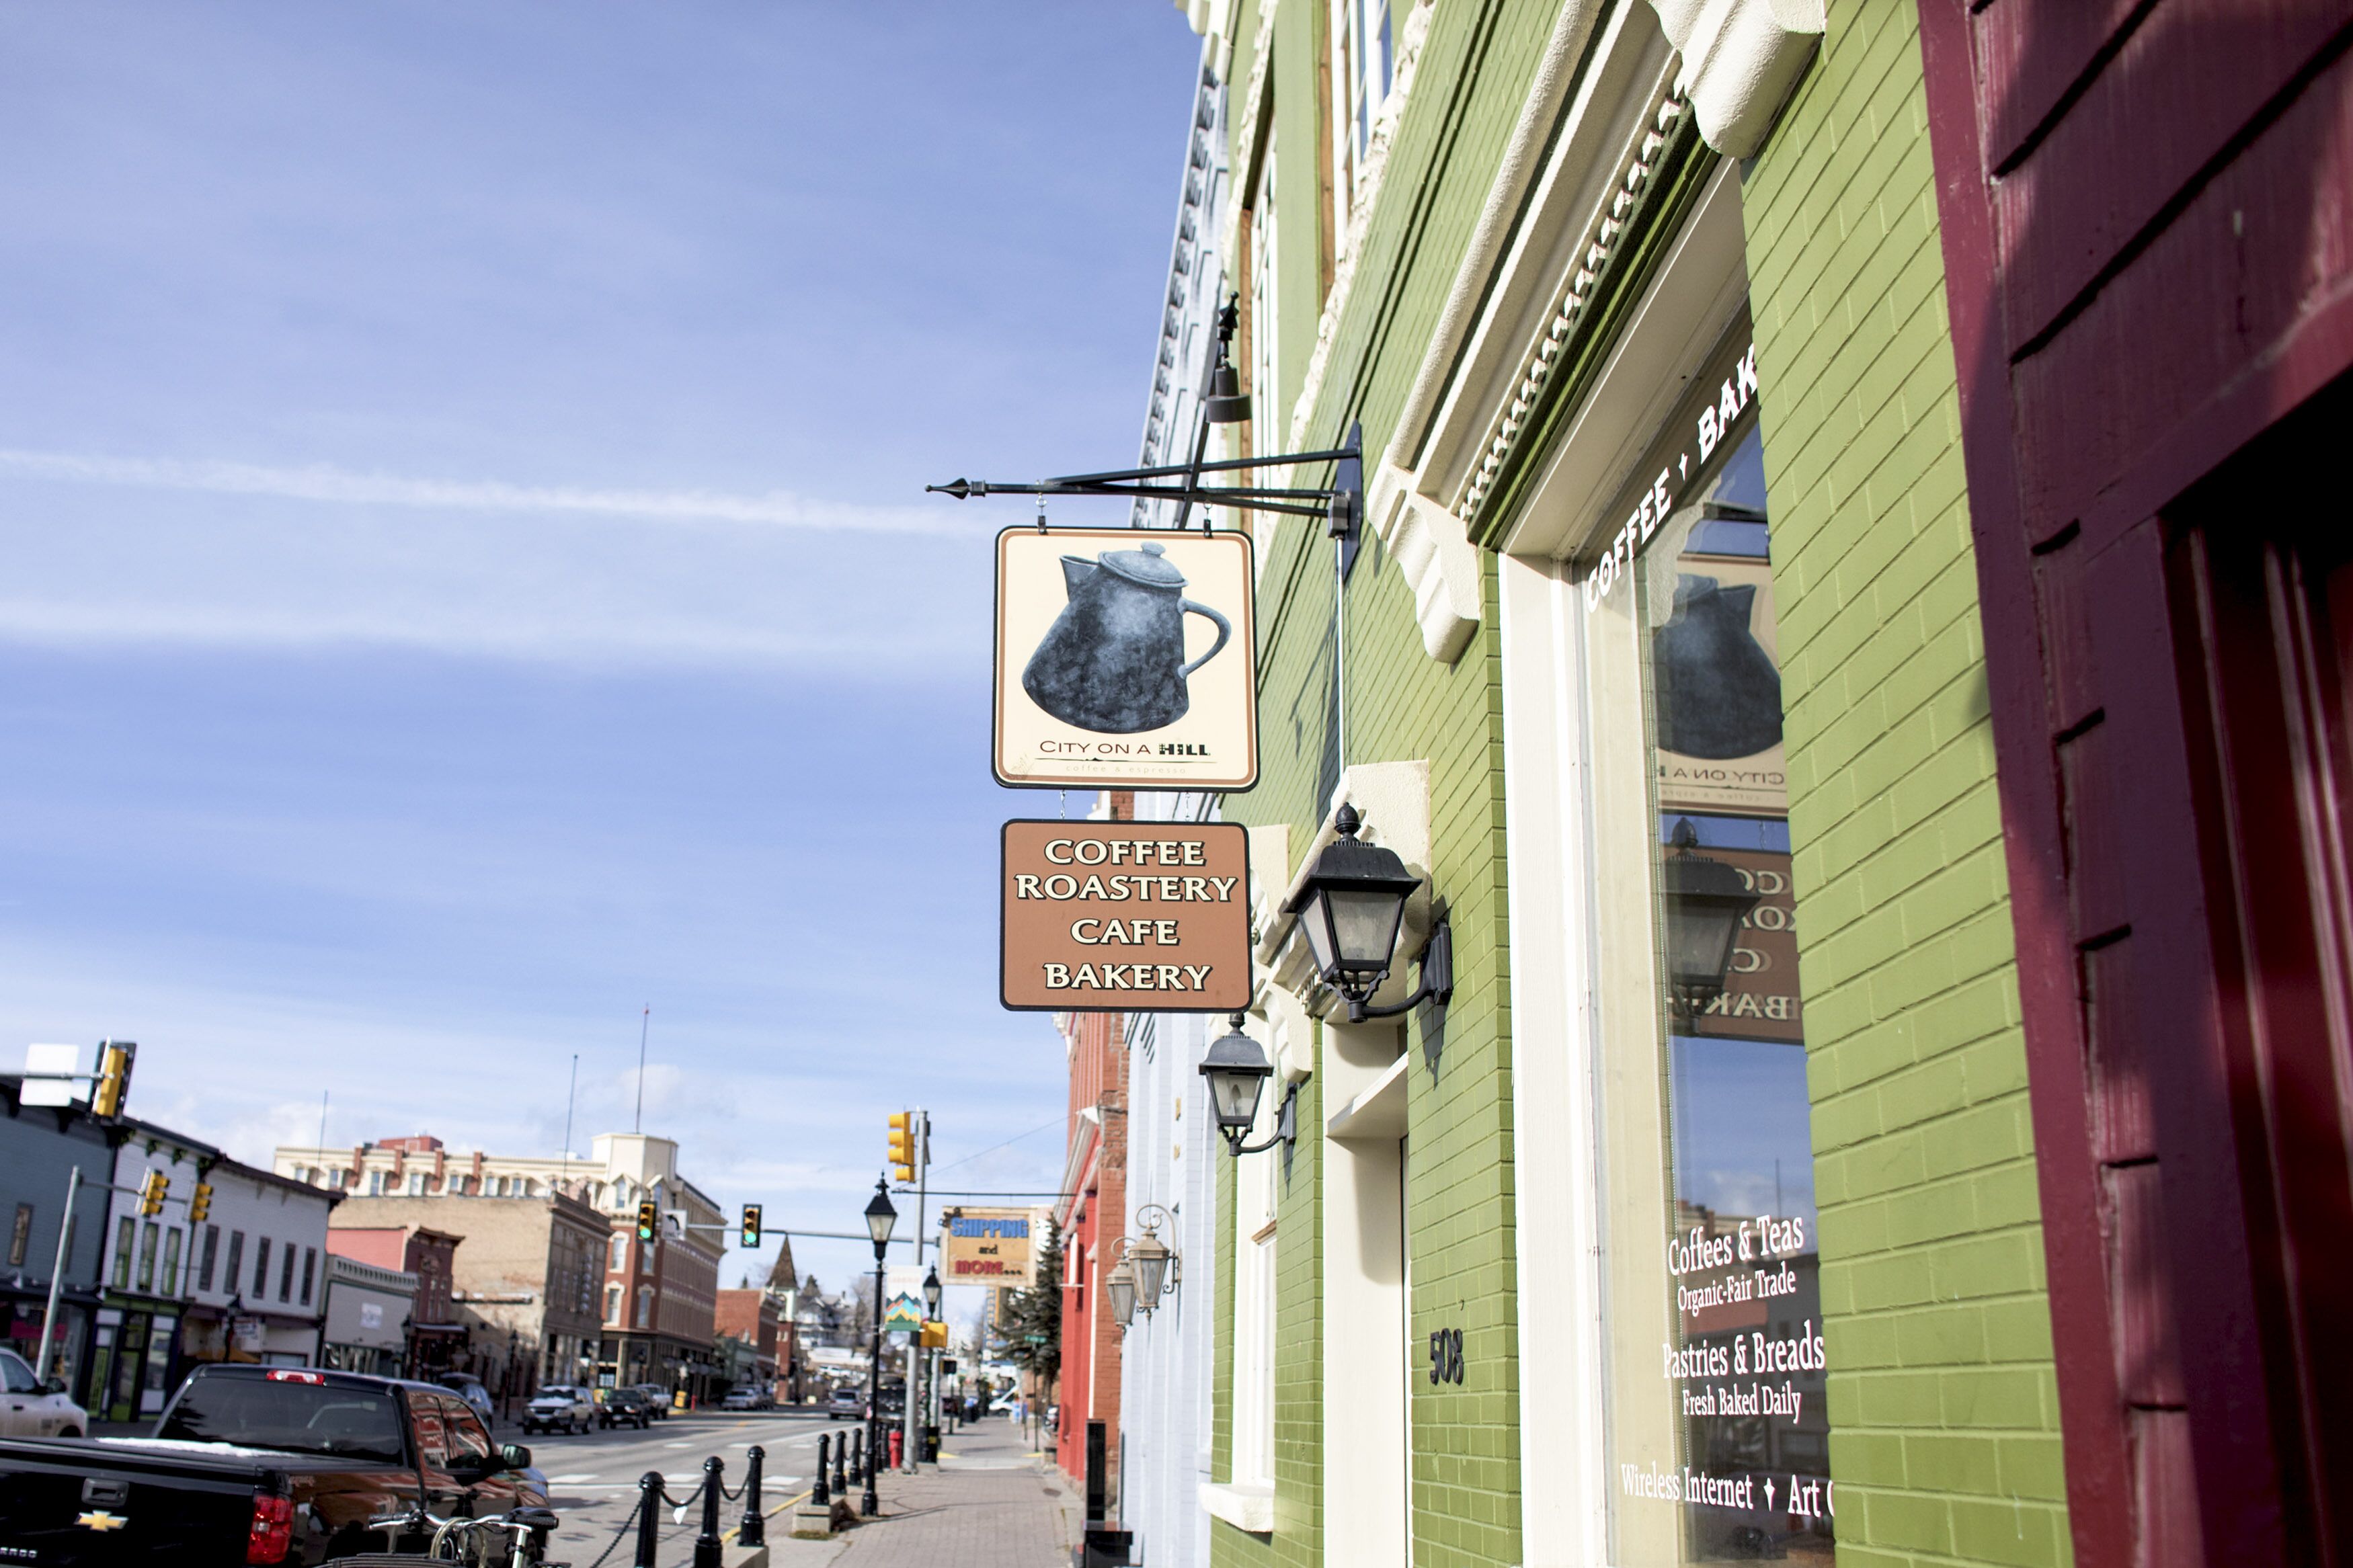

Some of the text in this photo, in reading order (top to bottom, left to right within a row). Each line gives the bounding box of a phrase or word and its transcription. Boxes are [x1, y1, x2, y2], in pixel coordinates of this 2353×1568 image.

[1587, 467, 1671, 613] COFFEE
[1098, 743, 1129, 754] ON
[1137, 745, 1151, 754] A
[1159, 743, 1210, 756] HILL
[1066, 764, 1106, 772] coffee
[1129, 767, 1186, 775] espresso
[1044, 839, 1207, 866] COFFEE
[1014, 874, 1238, 902] ROASTERY
[1070, 918, 1180, 946] CAFE
[1043, 963, 1213, 991] BAKERY
[951, 1216, 1029, 1238] SHIPPING
[979, 1244, 998, 1254] and
[1668, 1214, 1804, 1276] Coffees & Teas
[1678, 1261, 1796, 1317] Organic-Fair Trade
[1430, 1328, 1464, 1386] 508
[1663, 1319, 1826, 1379] Pastries & Breads
[1683, 1380, 1802, 1424] Fresh Baked Daily
[1621, 1461, 1679, 1500] Wireless
[1684, 1467, 1753, 1510] Internet
[1788, 1474, 1821, 1518] Art
